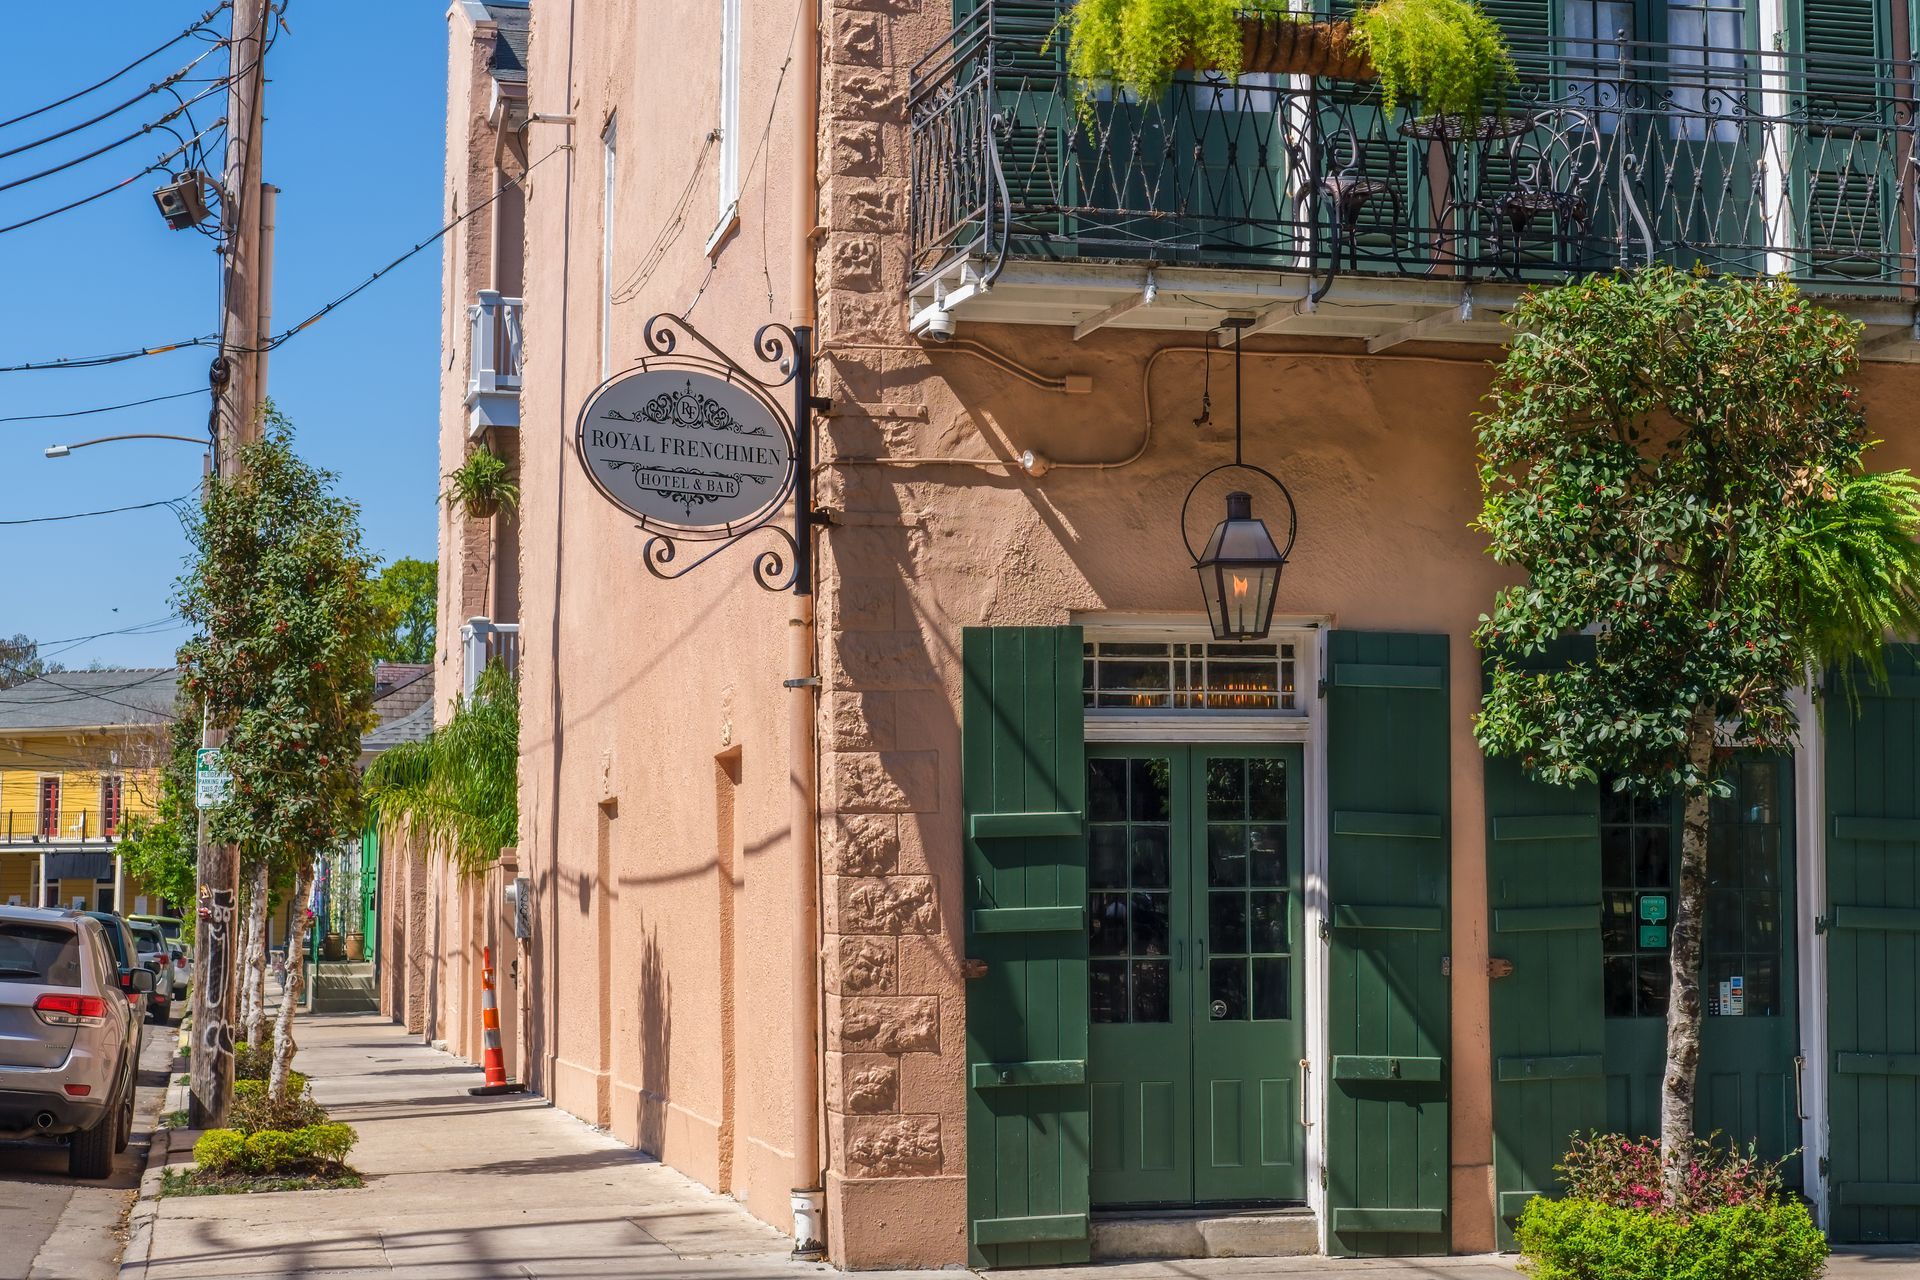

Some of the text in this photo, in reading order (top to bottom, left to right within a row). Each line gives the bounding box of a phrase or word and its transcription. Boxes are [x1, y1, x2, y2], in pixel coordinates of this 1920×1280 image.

[591, 429, 781, 465] ROYAL FRENCHMEN
[641, 473, 735, 494] HOTEL & BAR
